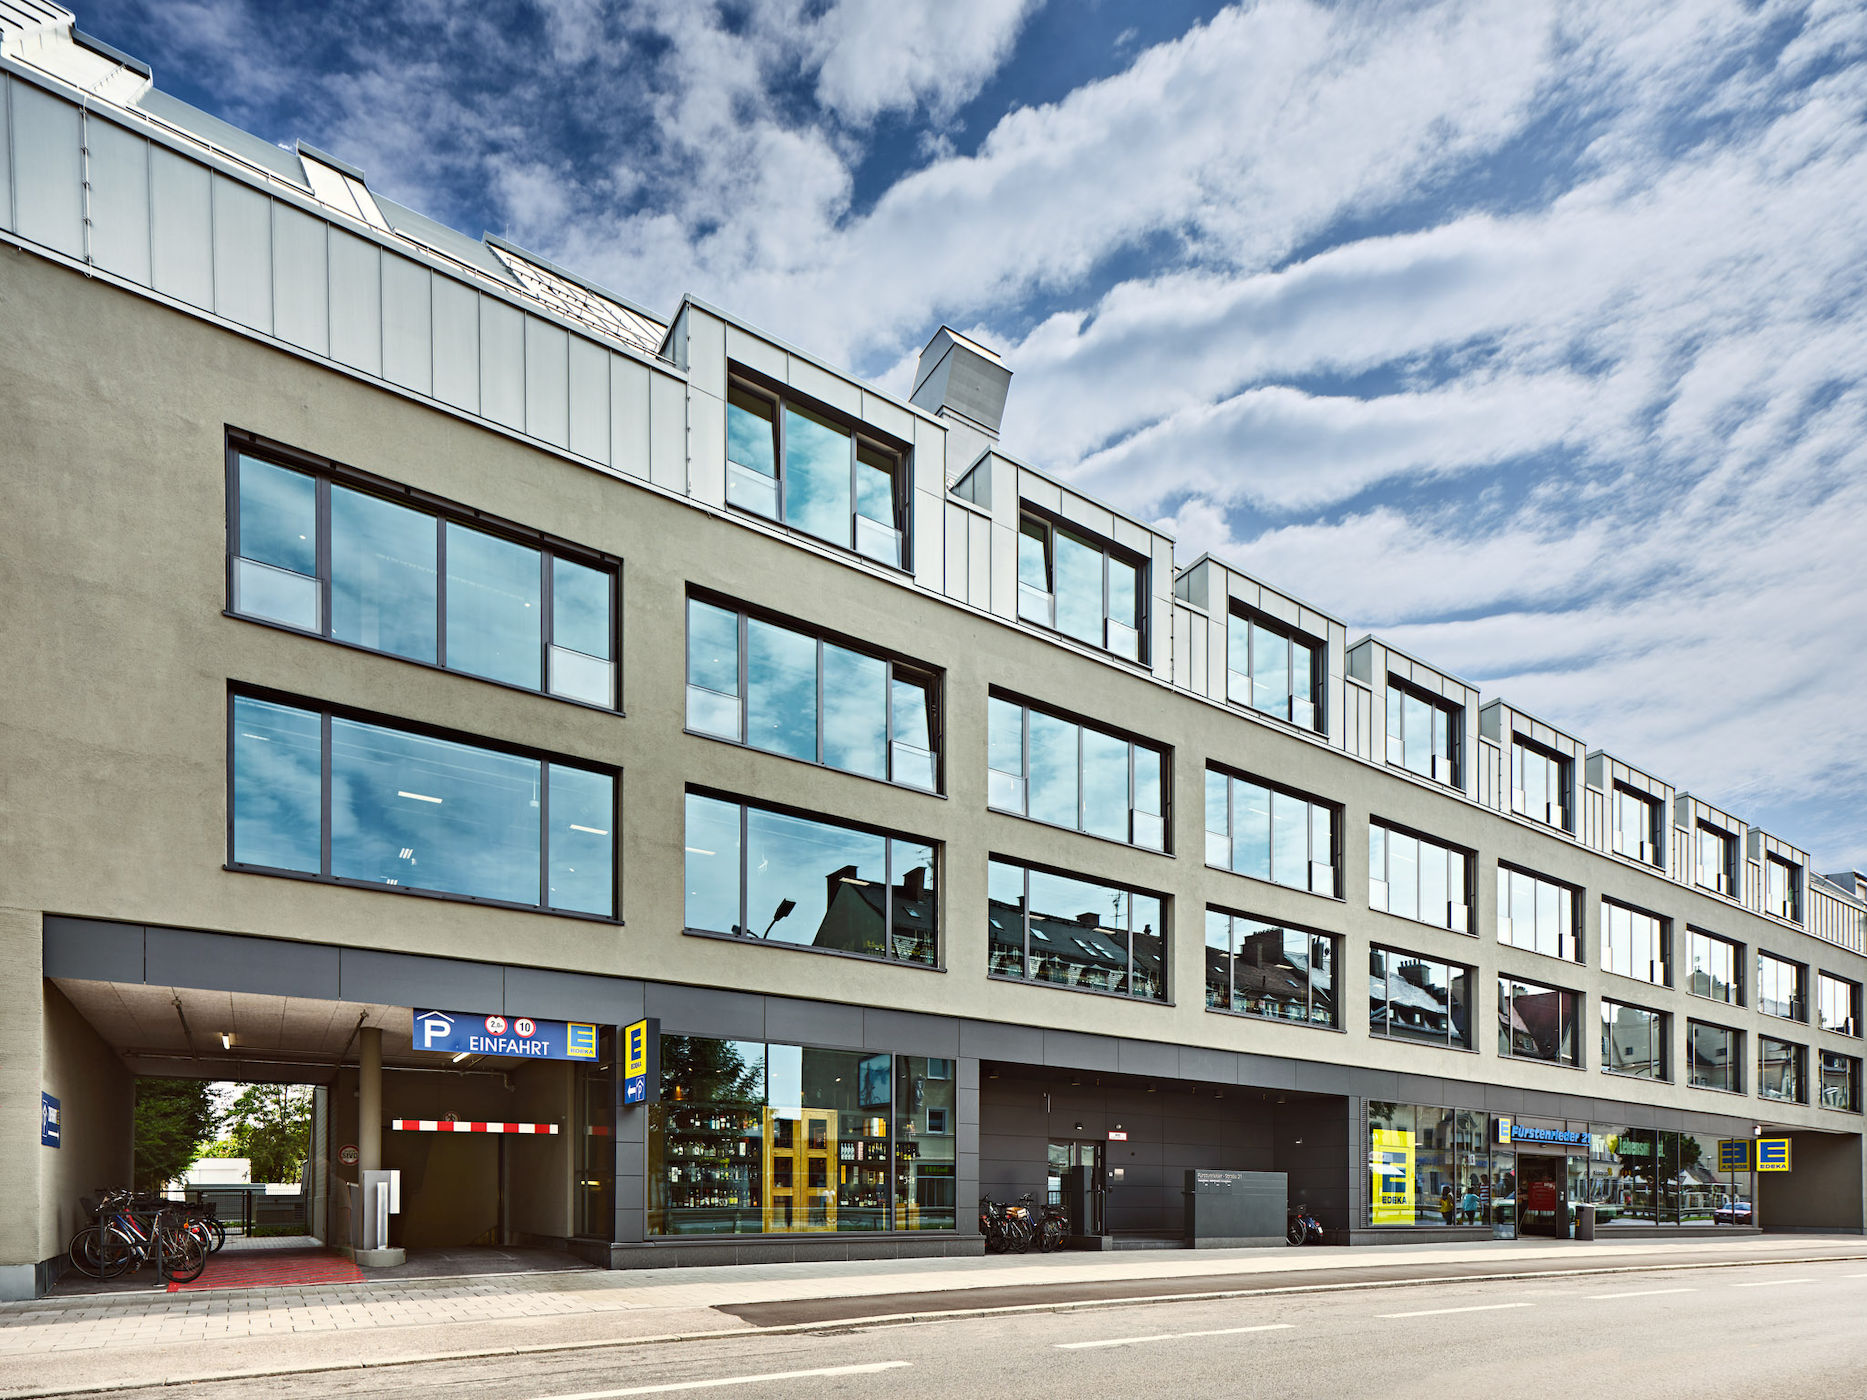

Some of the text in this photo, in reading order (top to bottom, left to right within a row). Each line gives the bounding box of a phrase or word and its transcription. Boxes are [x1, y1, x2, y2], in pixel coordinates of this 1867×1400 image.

[424, 1019, 451, 1048] P
[519, 1022, 531, 1032] 10
[469, 1036, 549, 1056] EINFAHRT
[1511, 1124, 1581, 1143] Fürstenrieder
[1382, 1196, 1407, 1204] EDEKA
